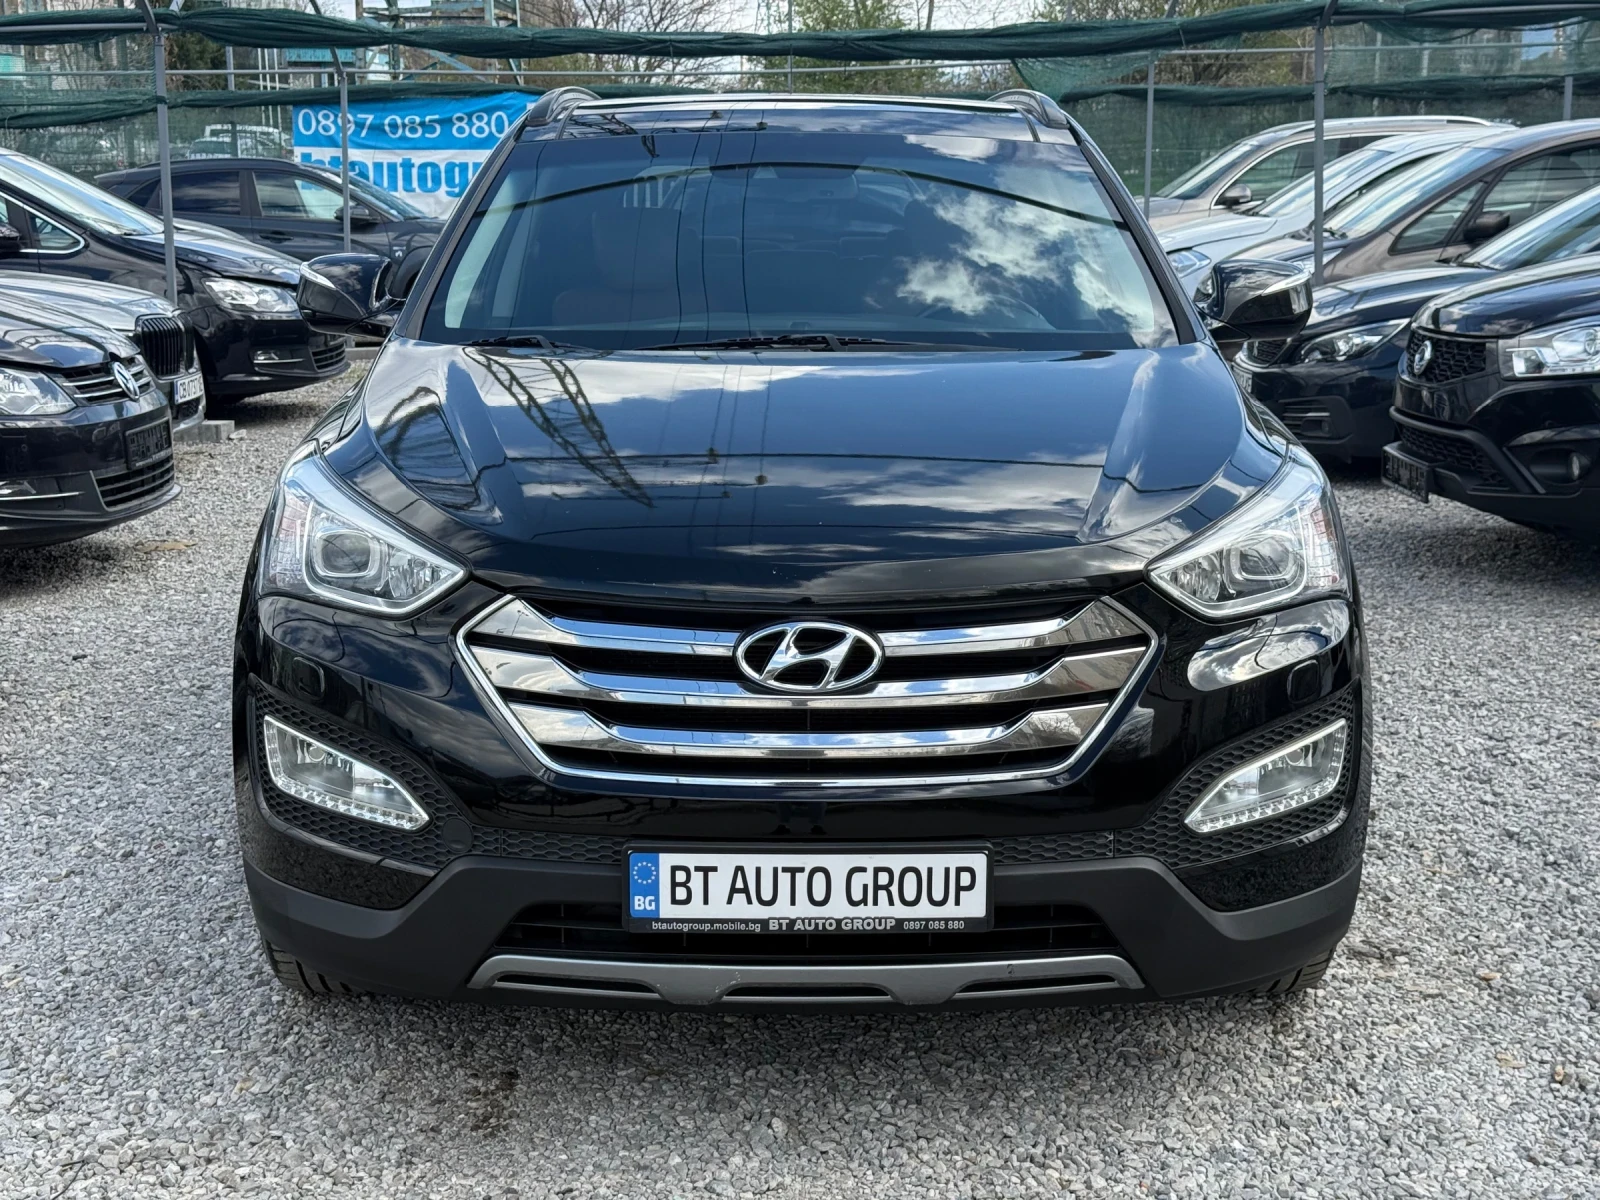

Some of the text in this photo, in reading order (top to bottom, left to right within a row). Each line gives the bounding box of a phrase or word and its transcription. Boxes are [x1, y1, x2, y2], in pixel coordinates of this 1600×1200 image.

[298, 109, 509, 139] 0897 085 880
[670, 865, 976, 907] BT AUTO GROUP
[634, 896, 655, 910] BG
[652, 918, 965, 932] btautogroup.mobile.bg BT AUTO GROUP 0897 085 880
